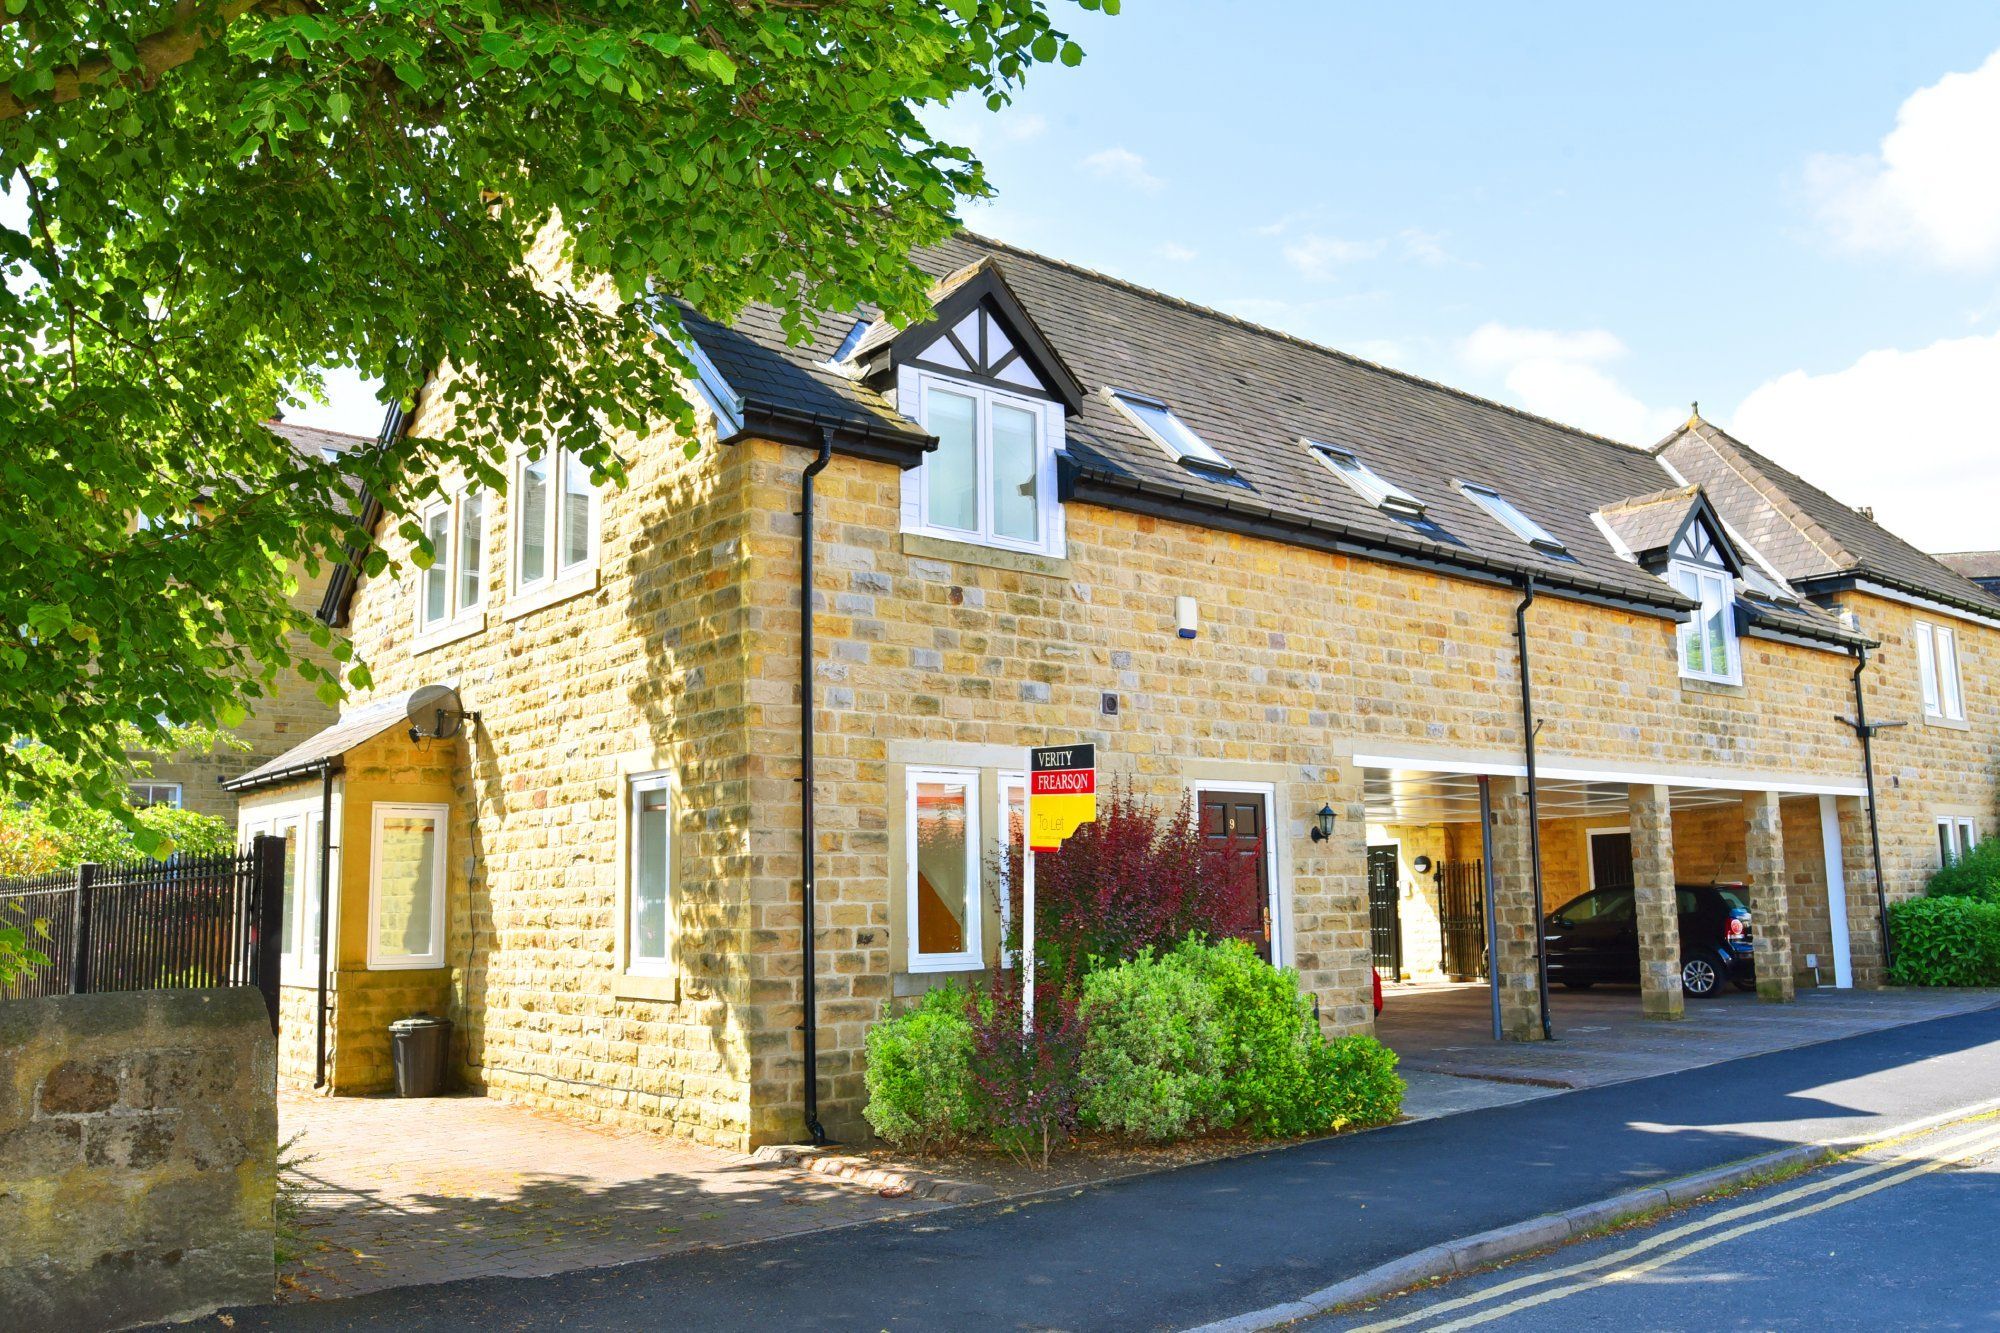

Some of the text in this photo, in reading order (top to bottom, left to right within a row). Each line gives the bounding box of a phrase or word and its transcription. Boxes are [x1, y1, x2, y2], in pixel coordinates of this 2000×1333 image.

[1038, 750, 1073, 767] VERITY
[1038, 773, 1088, 790] FREARSON
[1037, 813, 1064, 831] To Let
[1229, 818, 1235, 830] 9
